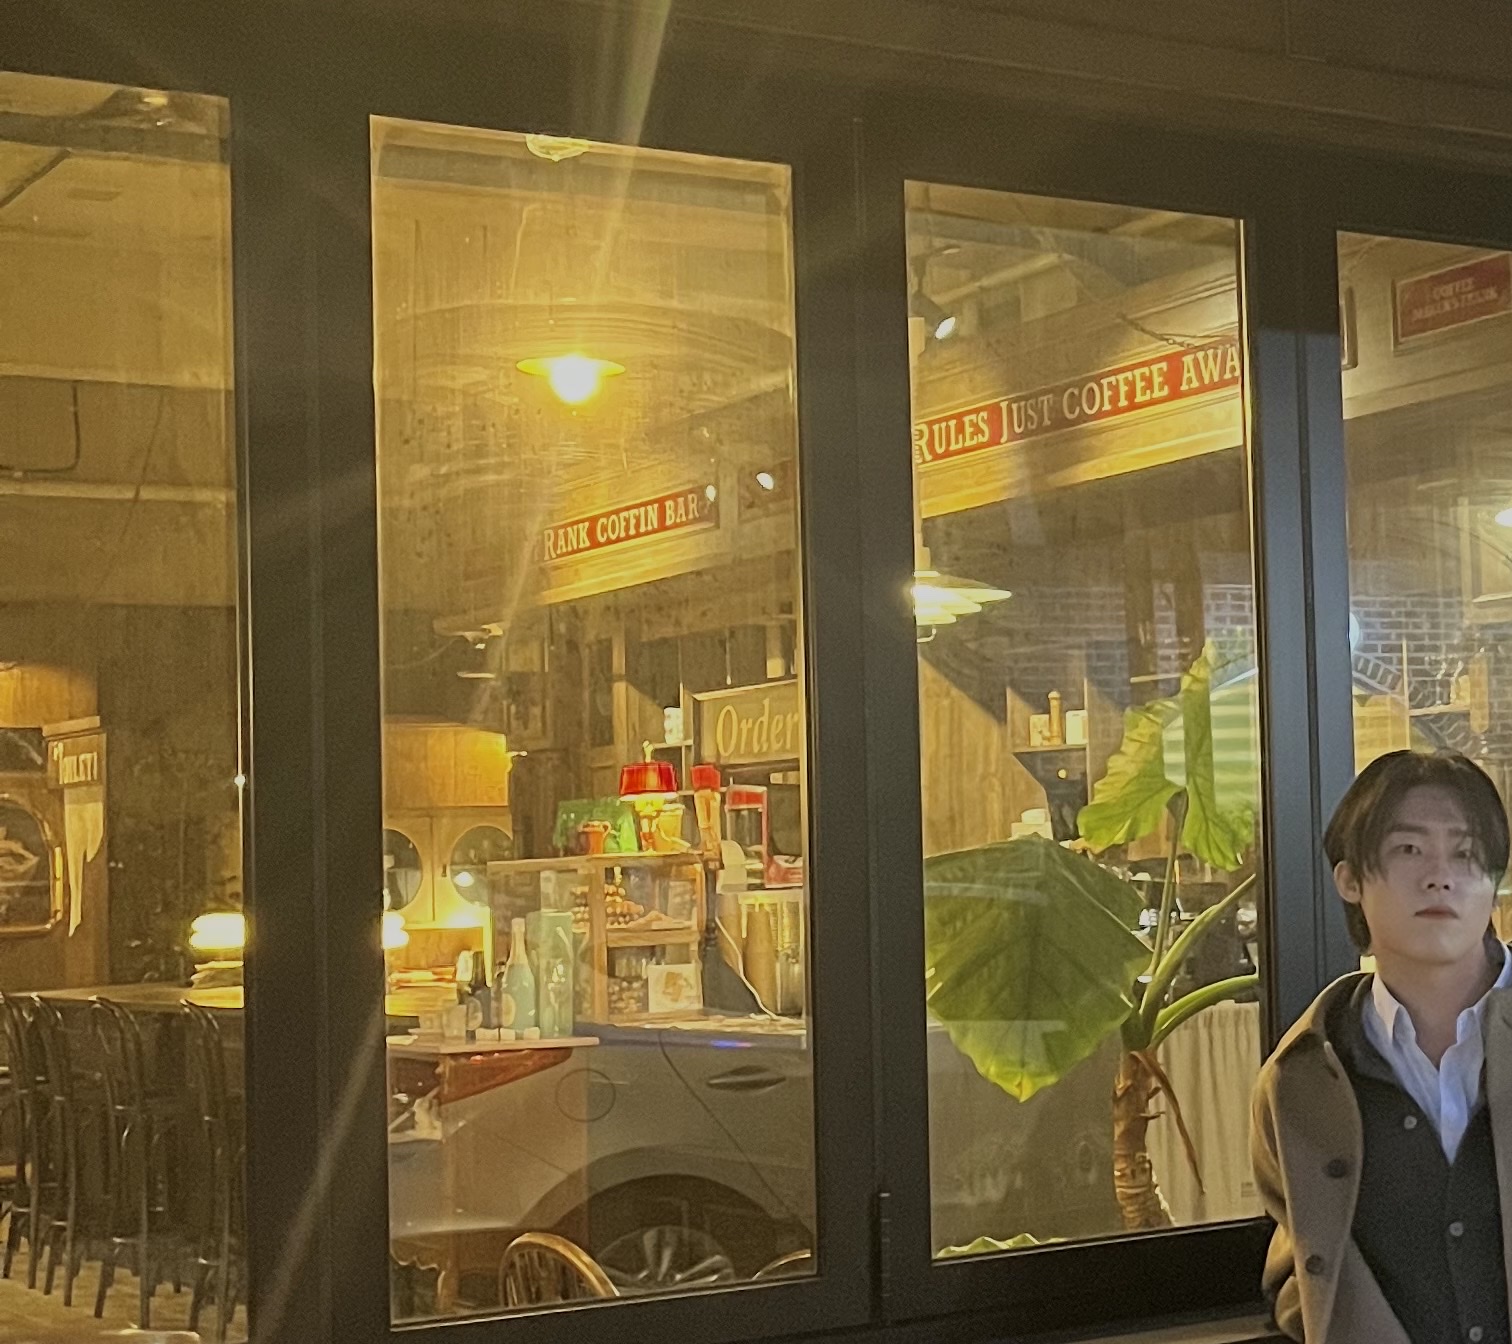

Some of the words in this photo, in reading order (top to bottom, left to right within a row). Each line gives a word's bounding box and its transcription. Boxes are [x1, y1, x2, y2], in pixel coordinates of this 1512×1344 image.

[1063, 362, 1168, 420] COFFEE
[596, 504, 659, 543] COFFIN
[665, 493, 700, 525] BAR
[716, 698, 799, 756] Order
